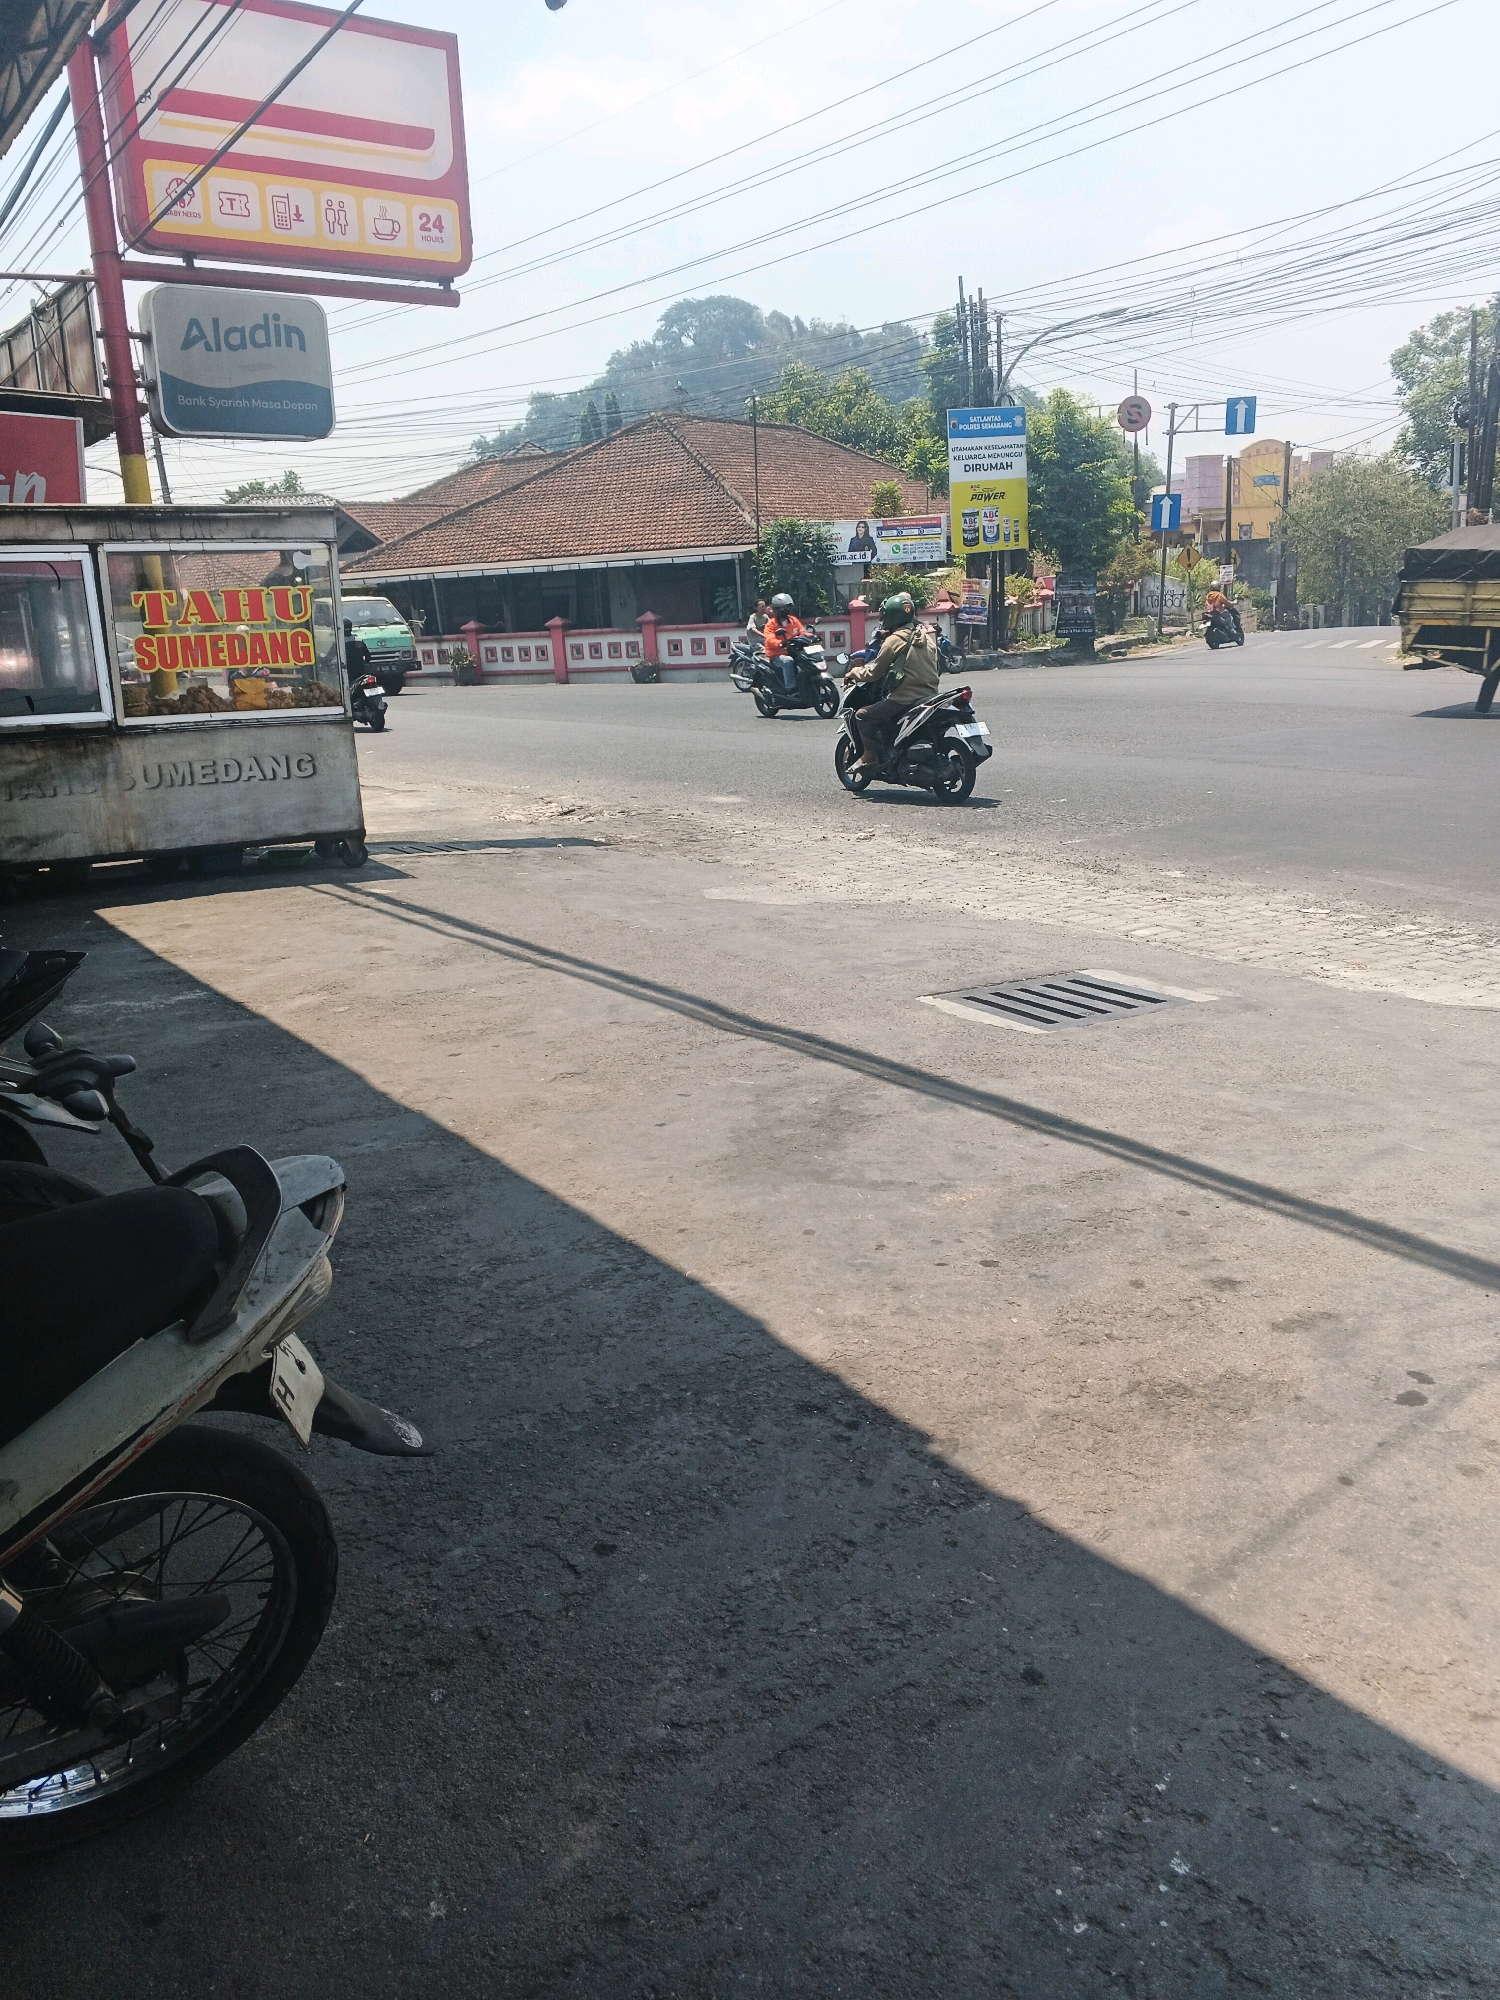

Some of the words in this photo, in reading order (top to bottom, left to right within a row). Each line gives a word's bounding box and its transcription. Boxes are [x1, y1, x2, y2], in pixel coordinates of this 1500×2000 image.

[418, 212, 445, 234] 24
[421, 235, 444, 243] HOURS
[180, 313, 306, 353] Aladin
[177, 395, 206, 407] Bank
[208, 396, 249, 409] Syariah
[251, 399, 281, 409] Masa
[283, 400, 317, 411] Depan
[969, 415, 1001, 423] SATLANTAS
[984, 443, 1024, 451] KESELAMATAN
[953, 453, 986, 461] KELUARGA
[963, 461, 1013, 473] DIRUMAH
[970, 491, 1006, 502] POWER
[983, 510, 999, 518] ABC
[963, 517, 978, 525] ABC
[131, 585, 315, 628] TAHU
[134, 628, 316, 673] SUMEDANG
